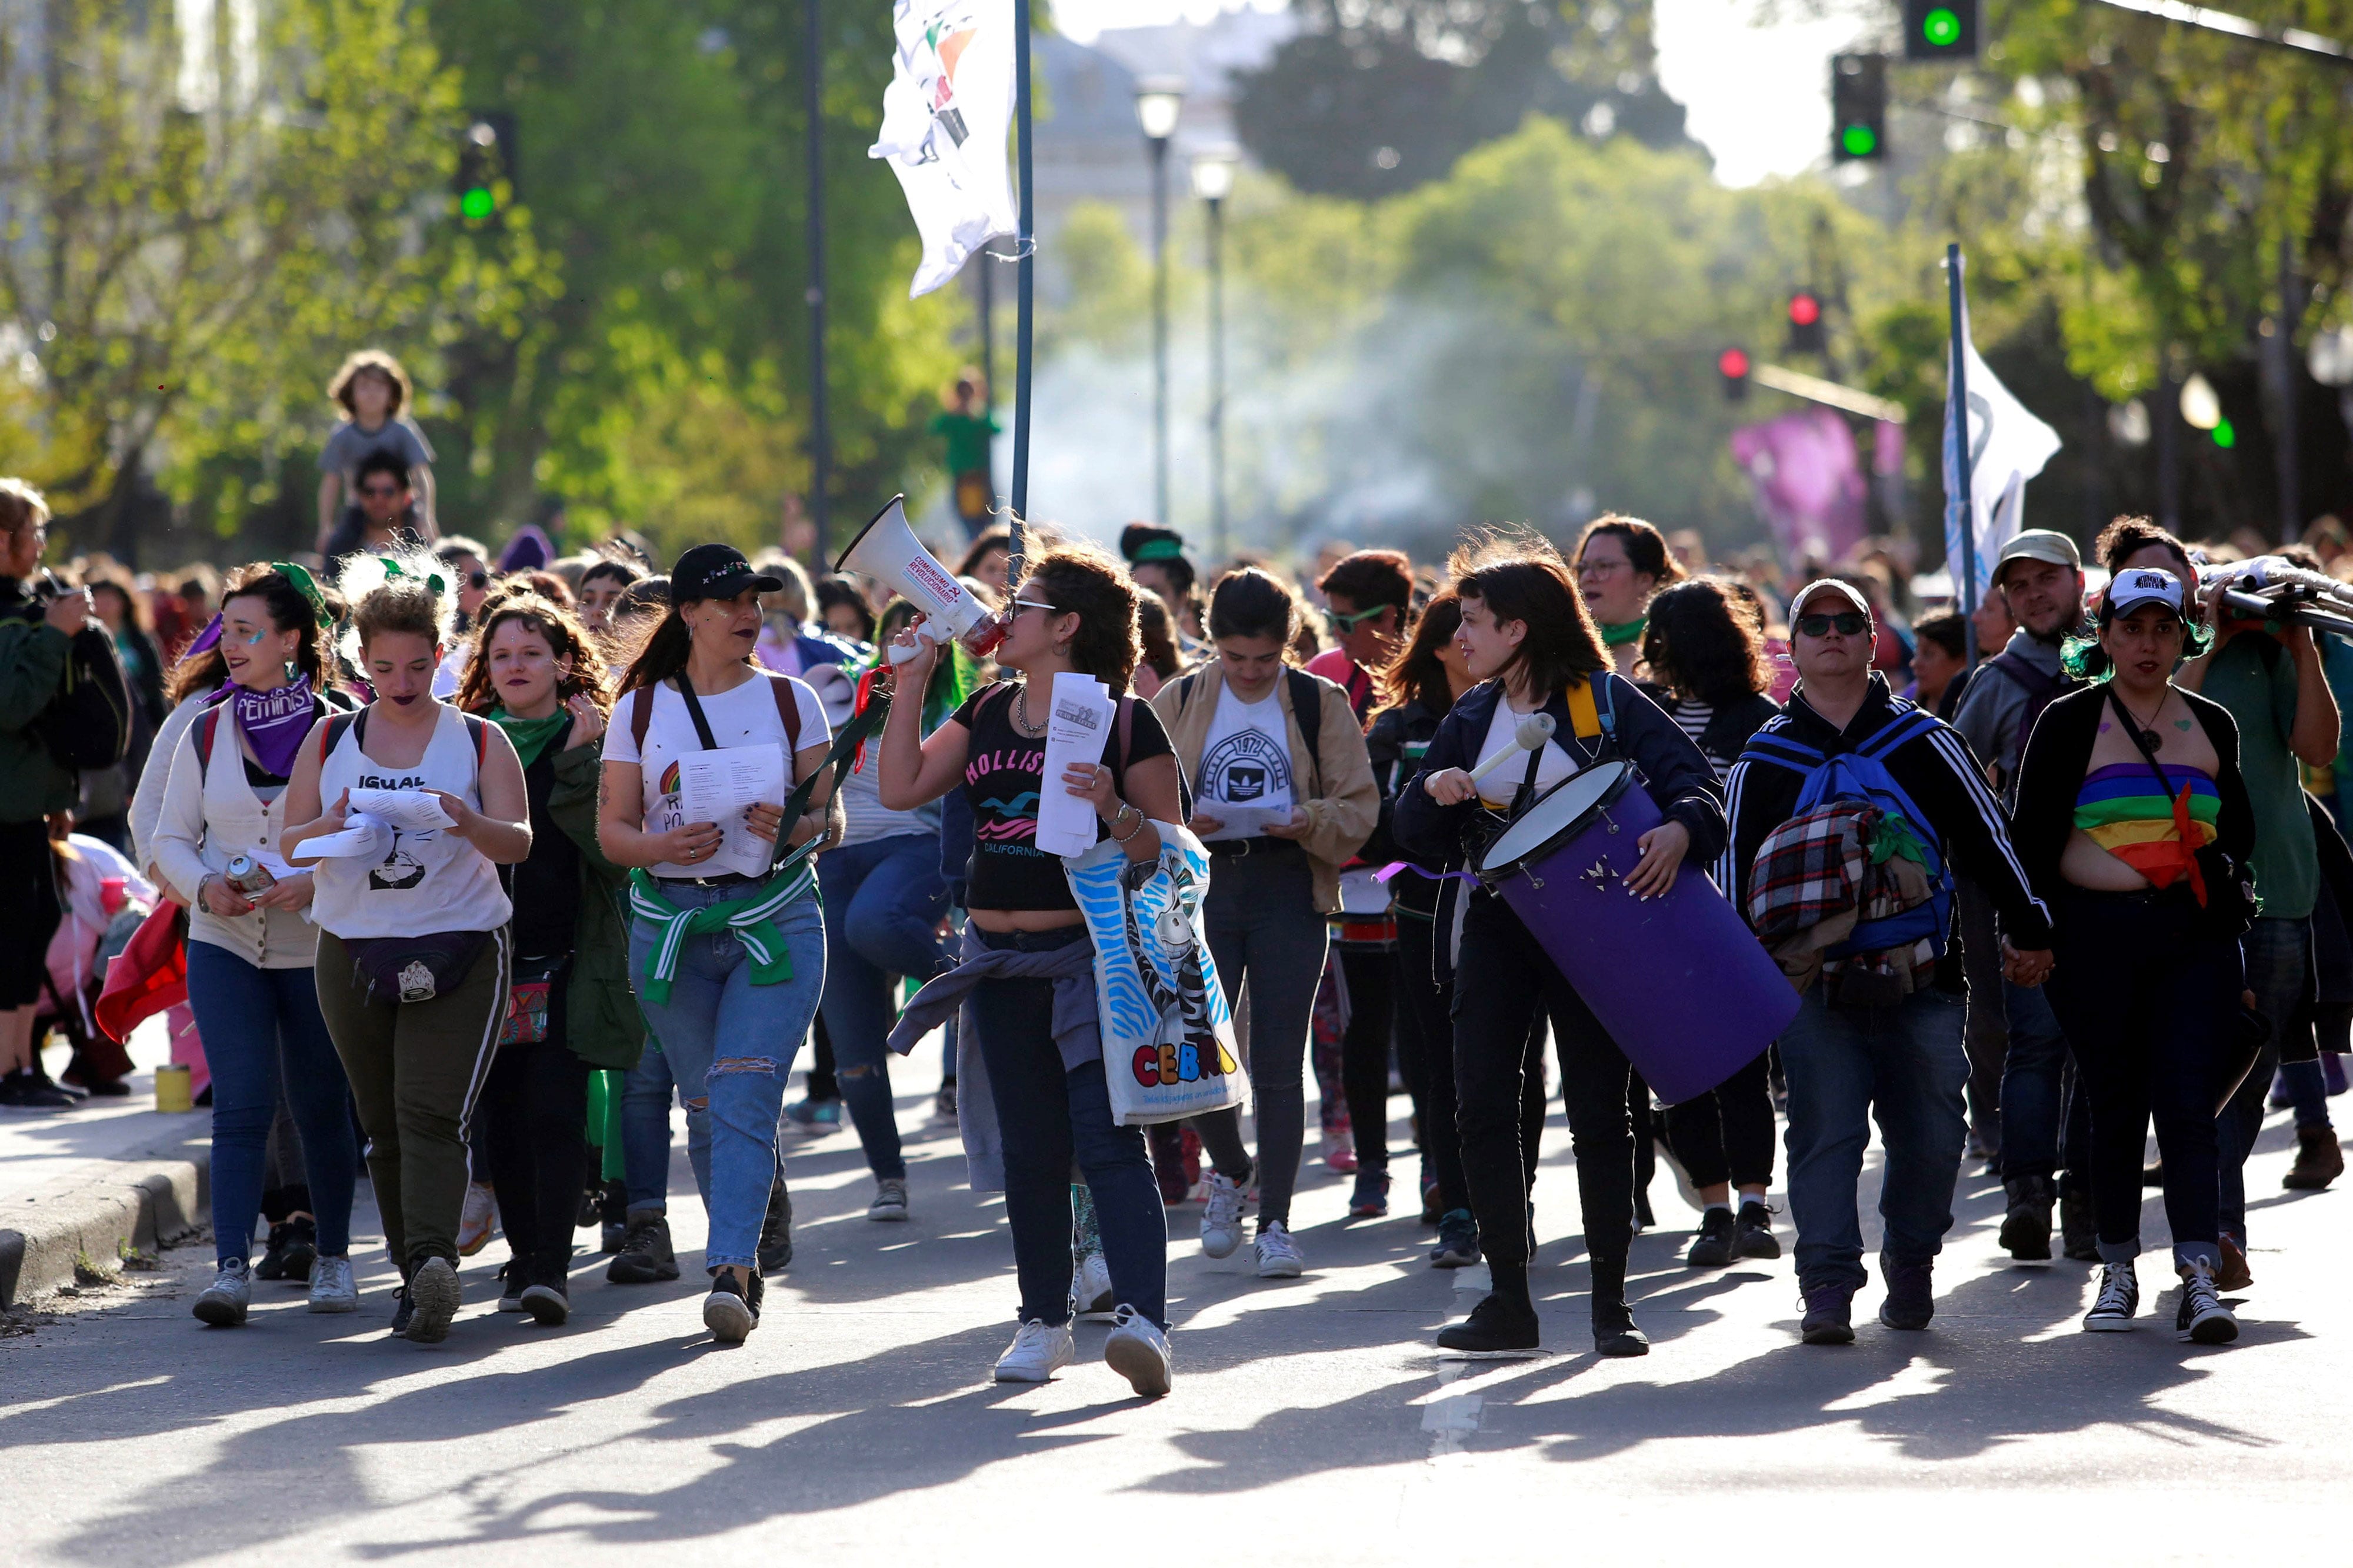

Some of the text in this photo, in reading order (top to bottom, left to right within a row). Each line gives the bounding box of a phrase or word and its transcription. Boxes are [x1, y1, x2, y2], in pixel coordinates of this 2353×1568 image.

[914, 556, 949, 588] COMUNISMO
[908, 562, 954, 603] REVOLUCIONARIO
[1237, 737, 1262, 753] 1972
[965, 750, 1044, 786] HOLLIS
[359, 775, 425, 790] IGUAL
[666, 795, 683, 810] R
[664, 812, 684, 831] PO
[985, 843, 1045, 858] CALIFORNIA
